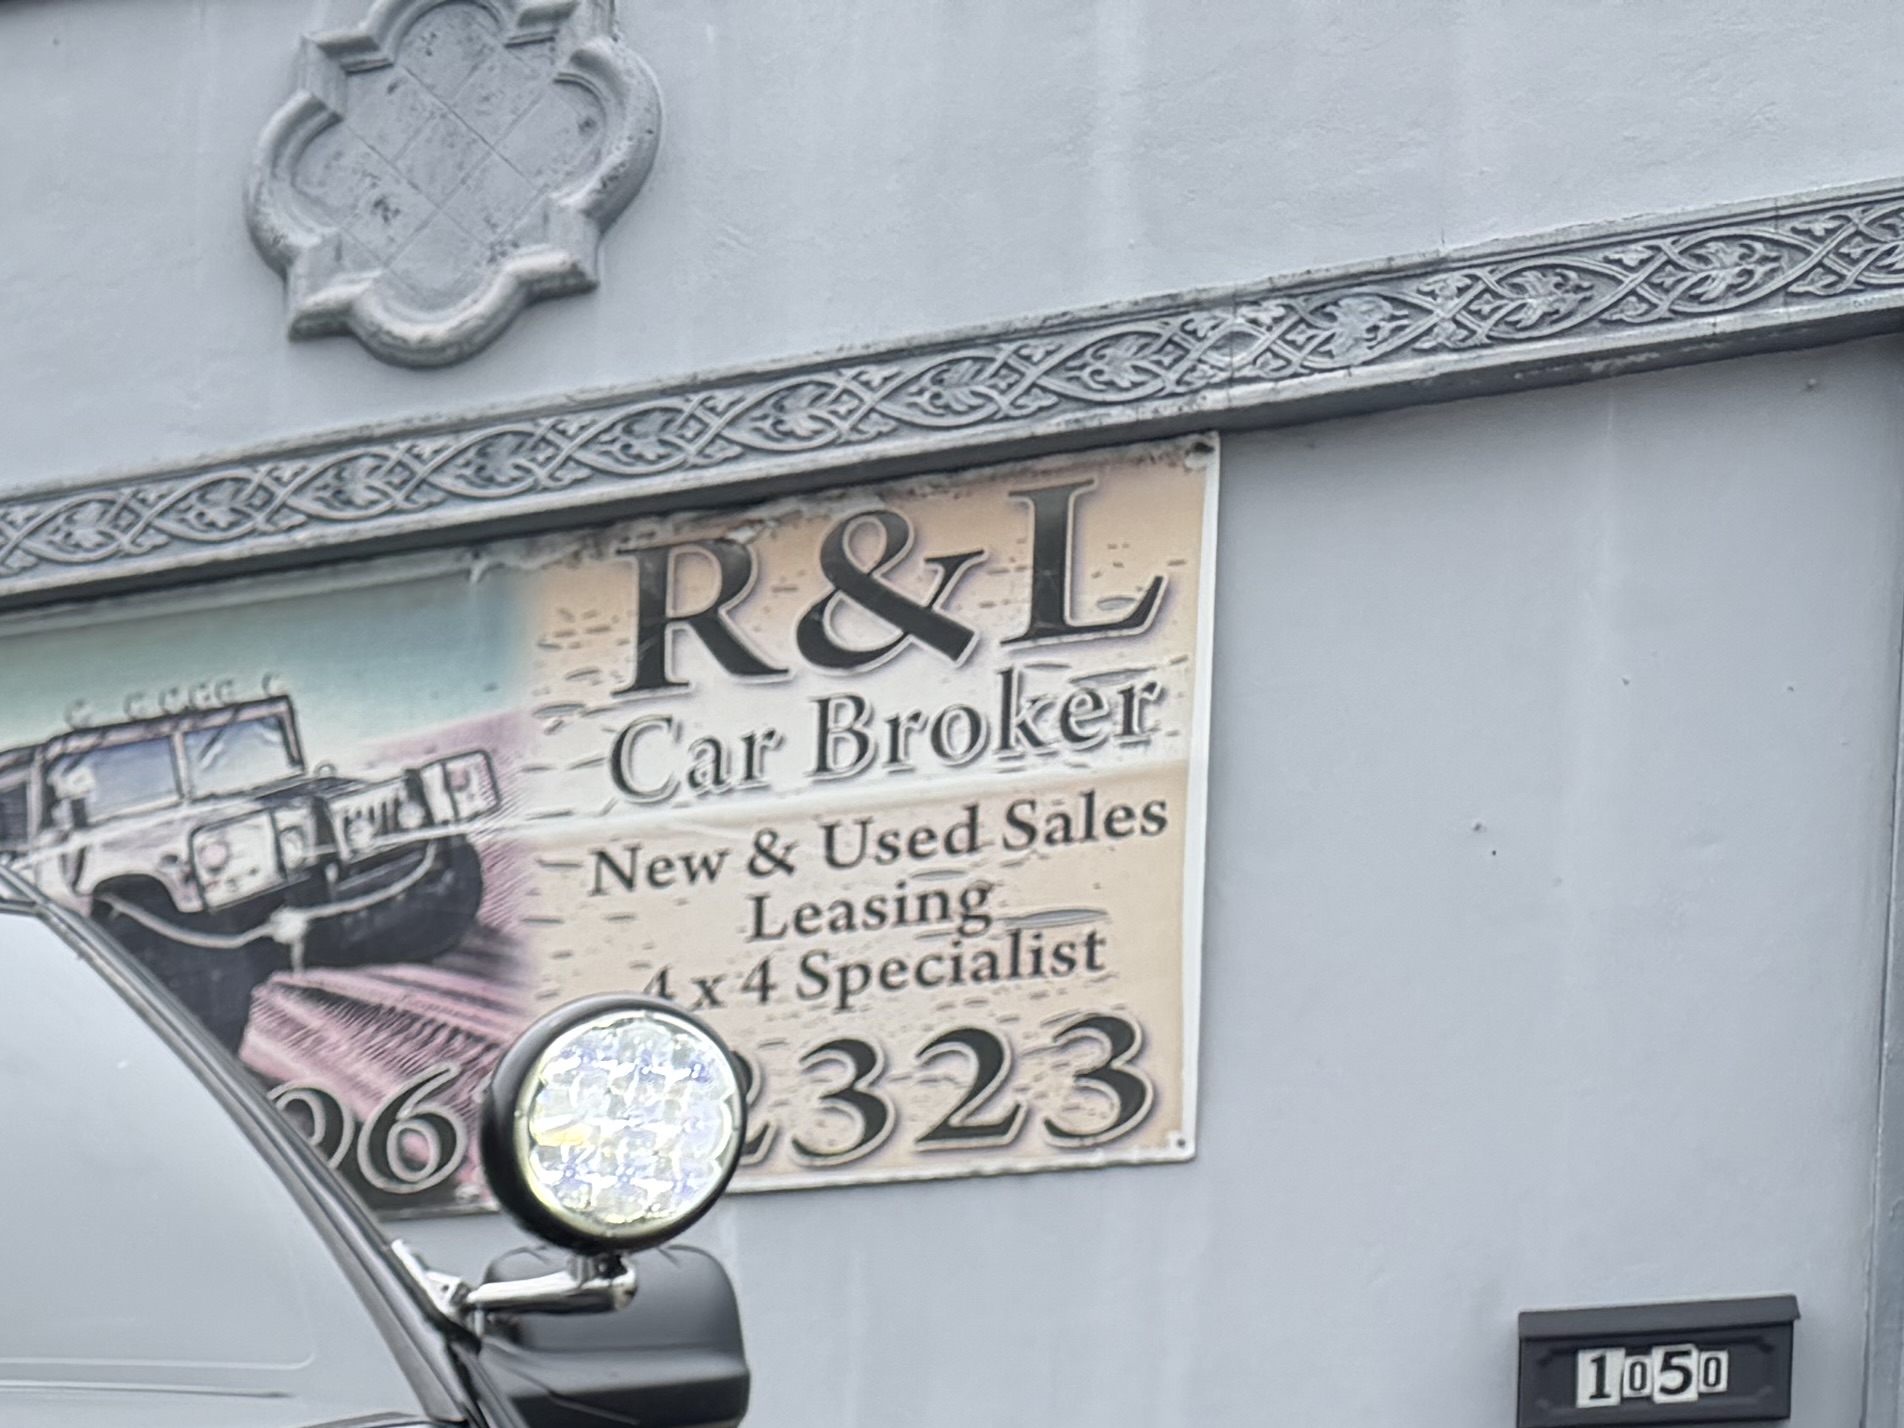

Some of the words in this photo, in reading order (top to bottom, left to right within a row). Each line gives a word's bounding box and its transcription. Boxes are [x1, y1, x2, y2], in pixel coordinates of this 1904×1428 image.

[609, 712, 783, 803] Car
[808, 666, 1164, 778] Broker
[590, 841, 730, 897] New
[746, 827, 796, 879] &
[822, 804, 986, 871] Used
[1002, 789, 1168, 853] Sales
[746, 878, 995, 943] Leasing
[690, 972, 725, 1011] x
[740, 957, 777, 1004] 4
[796, 929, 1107, 1014] Specialist
[1588, 1350, 1724, 1400] 1050
